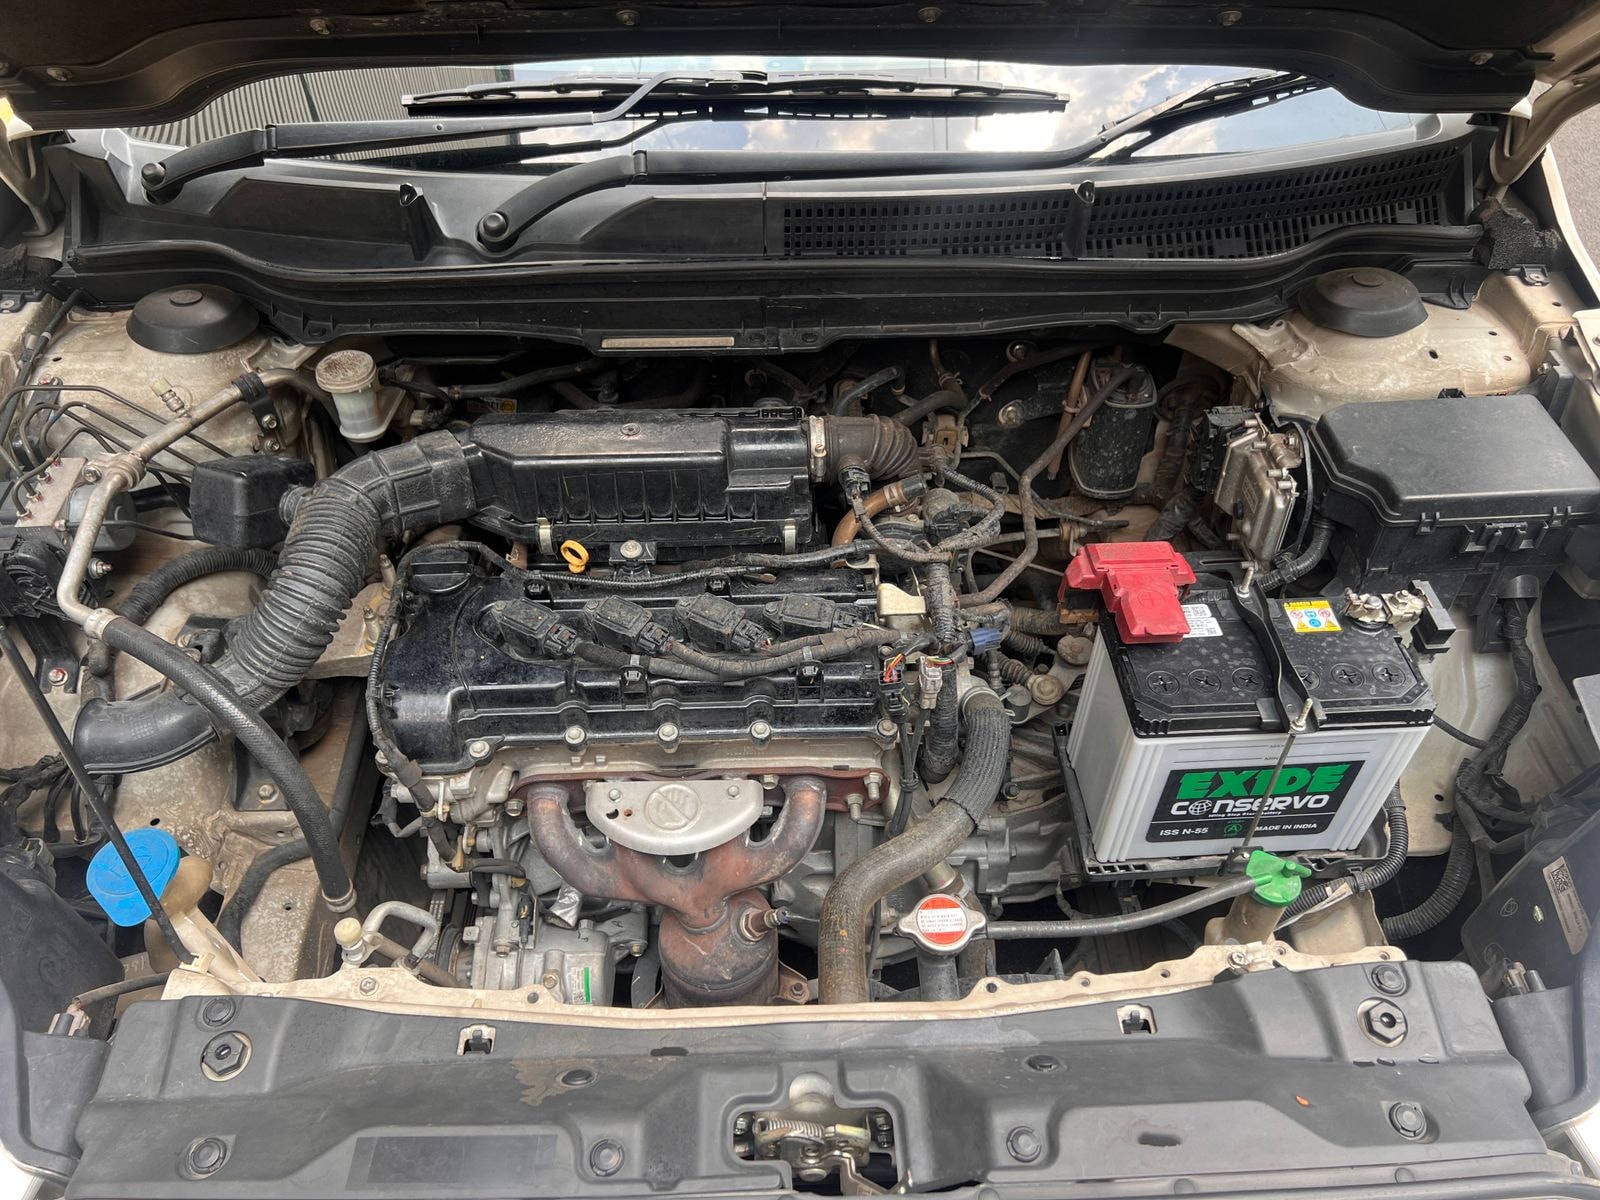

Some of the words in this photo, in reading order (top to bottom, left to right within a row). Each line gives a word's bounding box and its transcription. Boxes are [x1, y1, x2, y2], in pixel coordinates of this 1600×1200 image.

[1176, 763, 1351, 799] EXIDE
[1160, 828, 1179, 836] ISS
[1182, 827, 1209, 835] N-55
